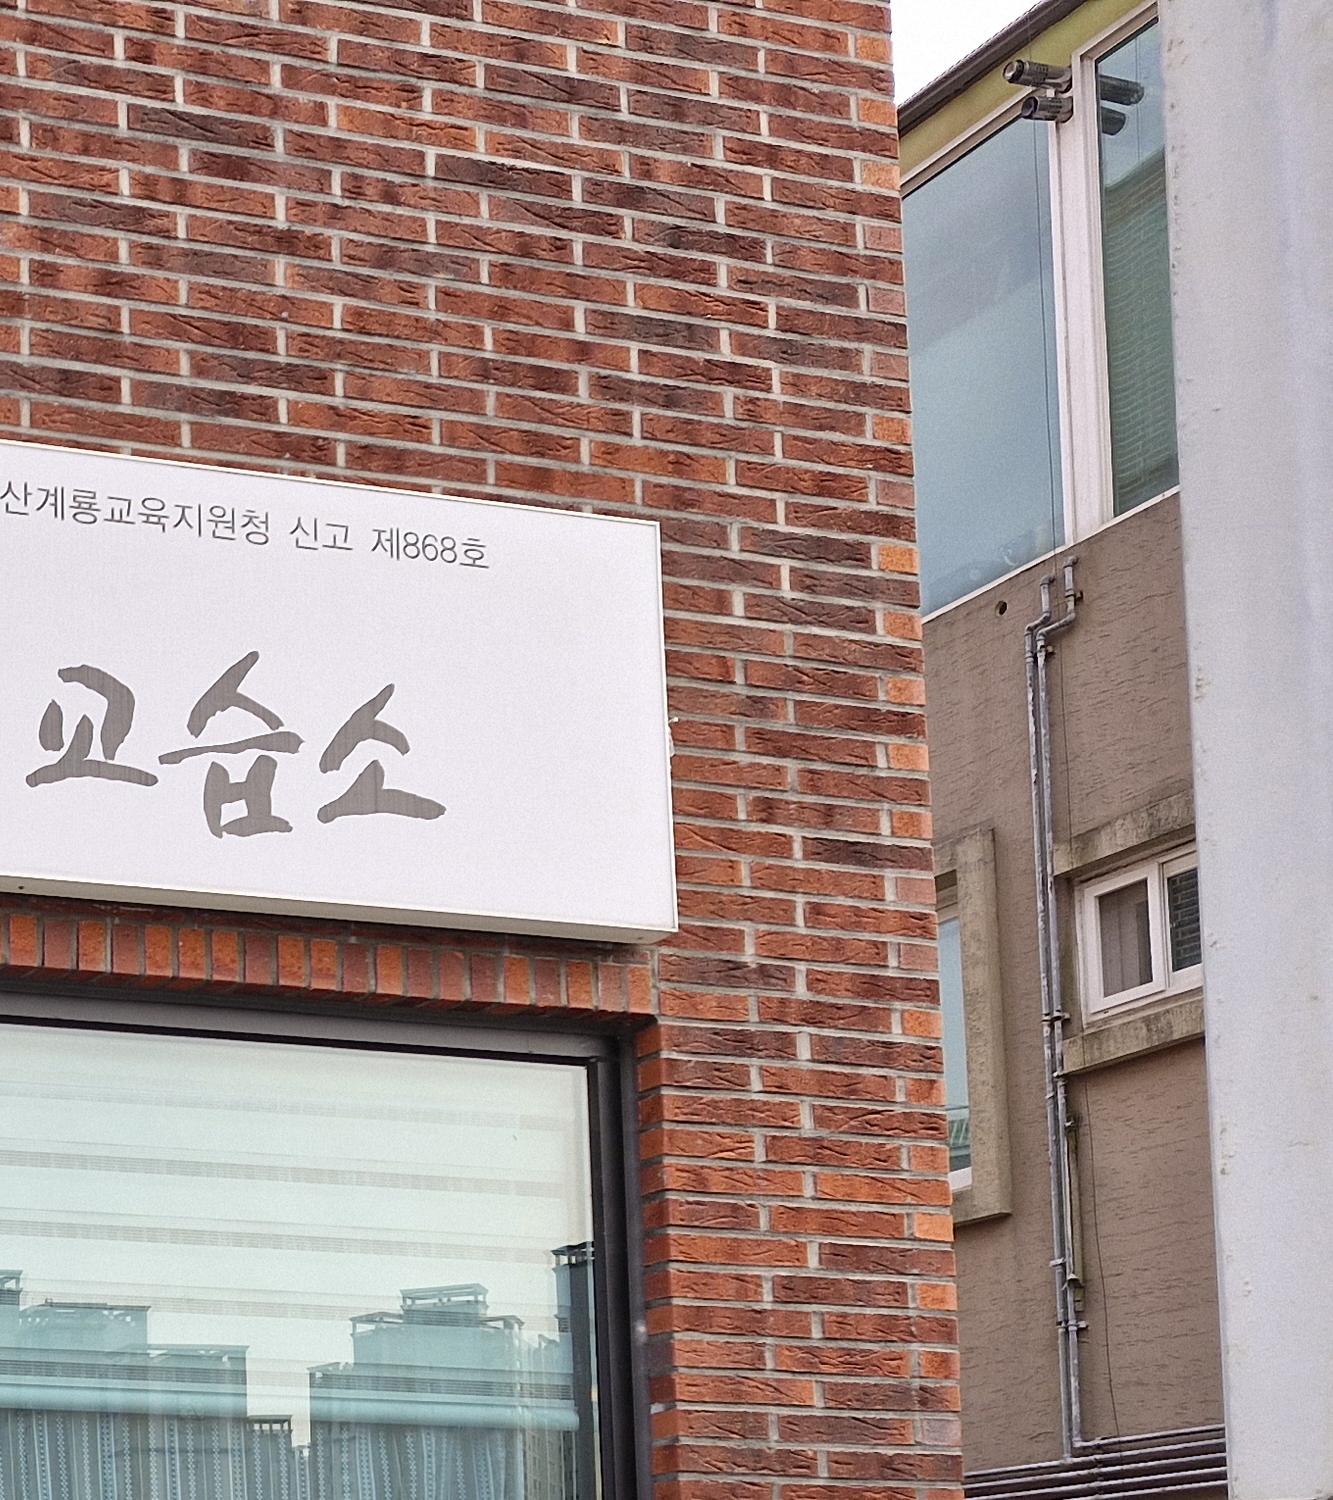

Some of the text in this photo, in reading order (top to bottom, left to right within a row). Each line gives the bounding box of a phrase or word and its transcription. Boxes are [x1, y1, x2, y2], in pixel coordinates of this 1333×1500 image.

[288, 515, 354, 553] 신고
[370, 526, 491, 571] 제868호
[27, 650, 446, 840] 교습소
